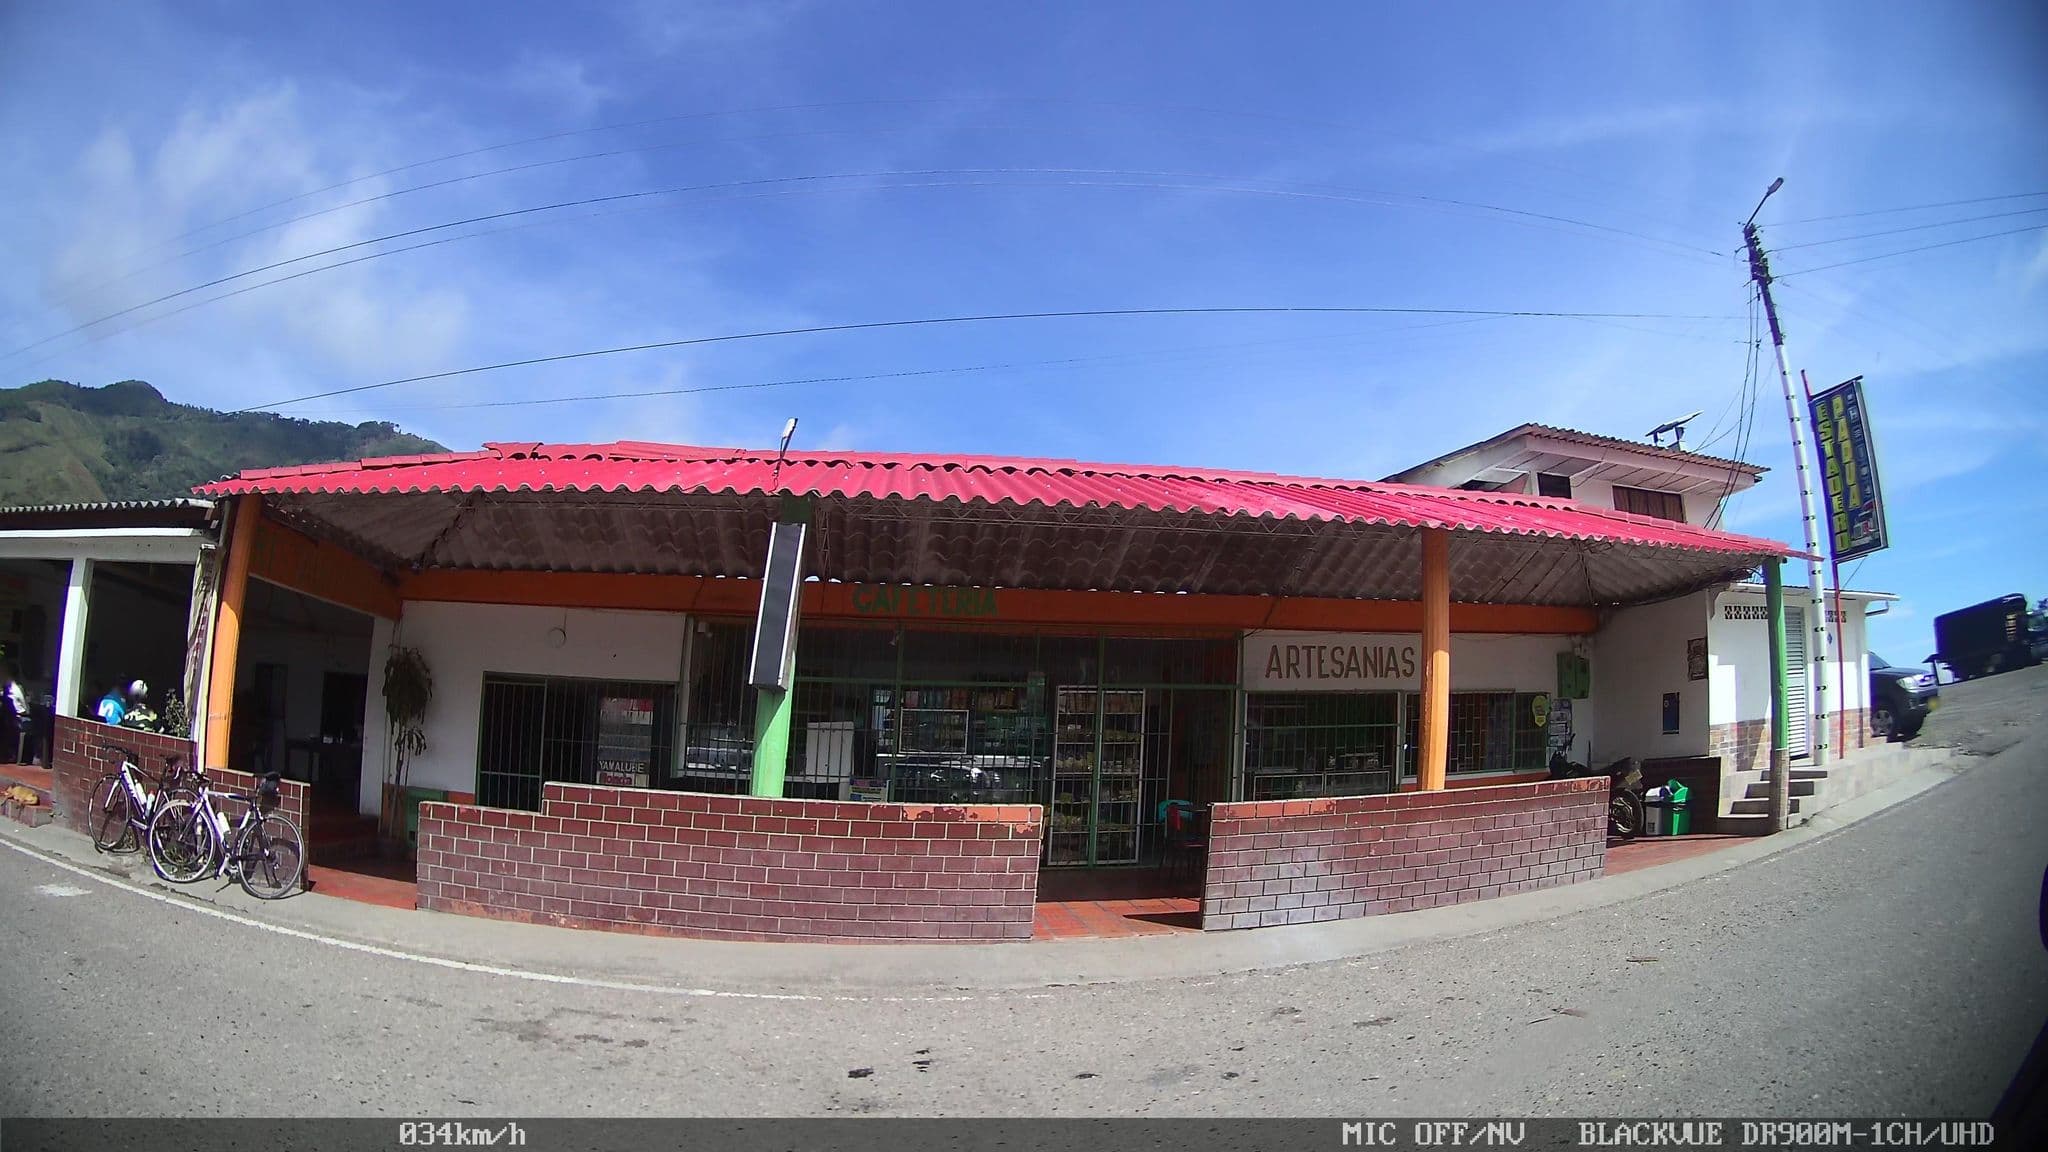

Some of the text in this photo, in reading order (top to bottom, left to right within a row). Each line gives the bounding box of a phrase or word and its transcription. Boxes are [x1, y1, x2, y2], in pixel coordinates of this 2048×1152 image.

[1815, 402, 1850, 553] ESTADERO
[1832, 395, 1861, 509] PADUA
[853, 586, 998, 616] CAFETERIA
[1265, 645, 1416, 679] ARTESANIAS
